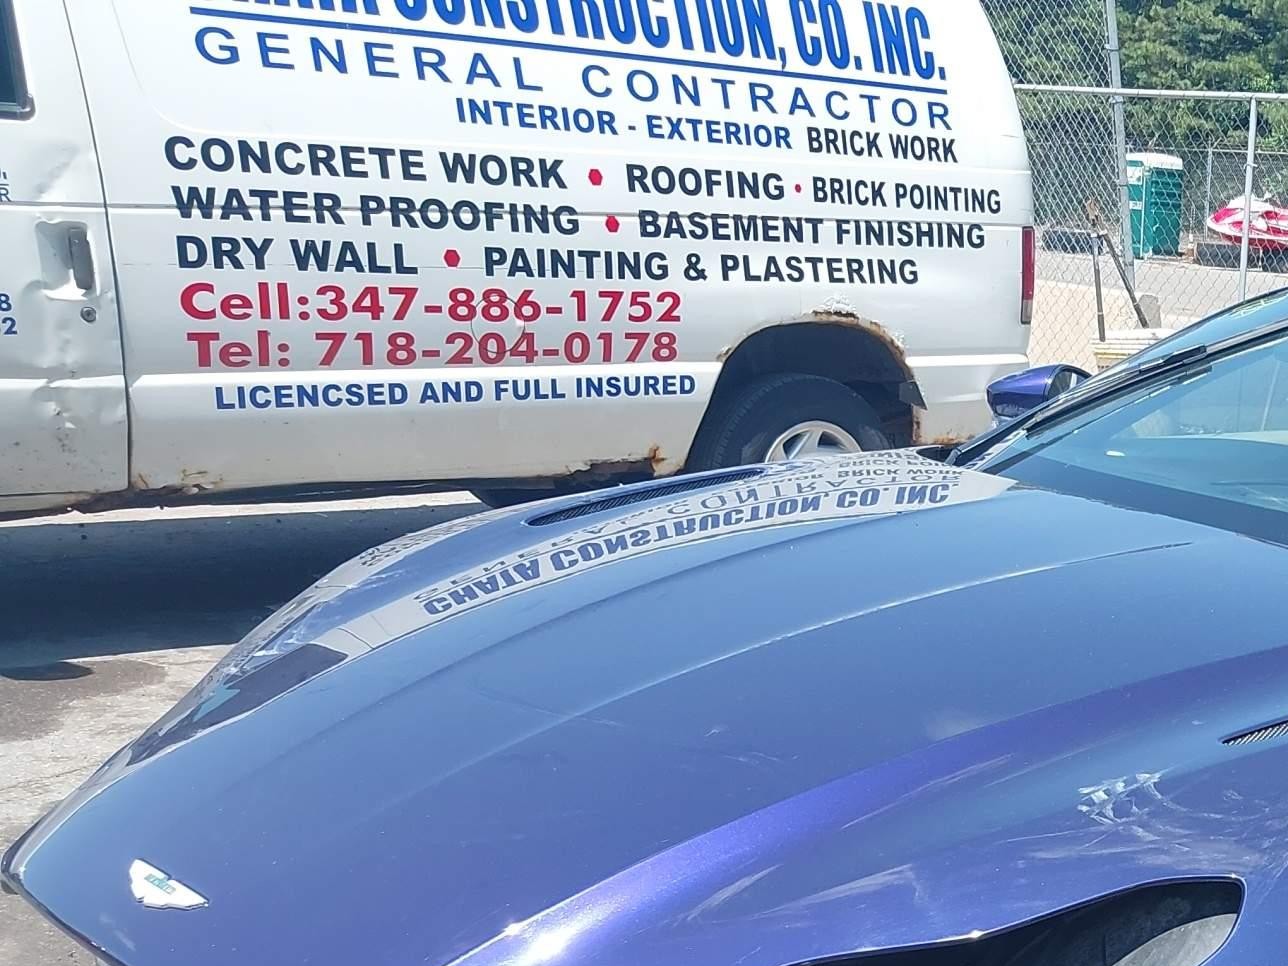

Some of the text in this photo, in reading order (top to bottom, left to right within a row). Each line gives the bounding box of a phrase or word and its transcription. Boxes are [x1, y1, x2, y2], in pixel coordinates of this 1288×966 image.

[394, 0, 787, 70] RUCTION,
[862, 1, 947, 80] INC.
[194, 26, 952, 130] GENERAL CONTRACTOR
[456, 97, 619, 135] INTERIOR
[646, 114, 793, 149] EXTERIOR
[806, 126, 883, 158] BRICK
[888, 133, 958, 163] WORK
[164, 135, 1001, 214] CONCRETE WORK ROOFING BRICK POINTING
[171, 185, 985, 249] WATER PROOFING BASEMENT FINISHING
[176, 235, 919, 285] DRY WALL PAINTING & PLASTERING
[186, 329, 678, 368] Tel: 718-204-0178
[215, 374, 695, 410] LICENCSED AND FULL INSURED
